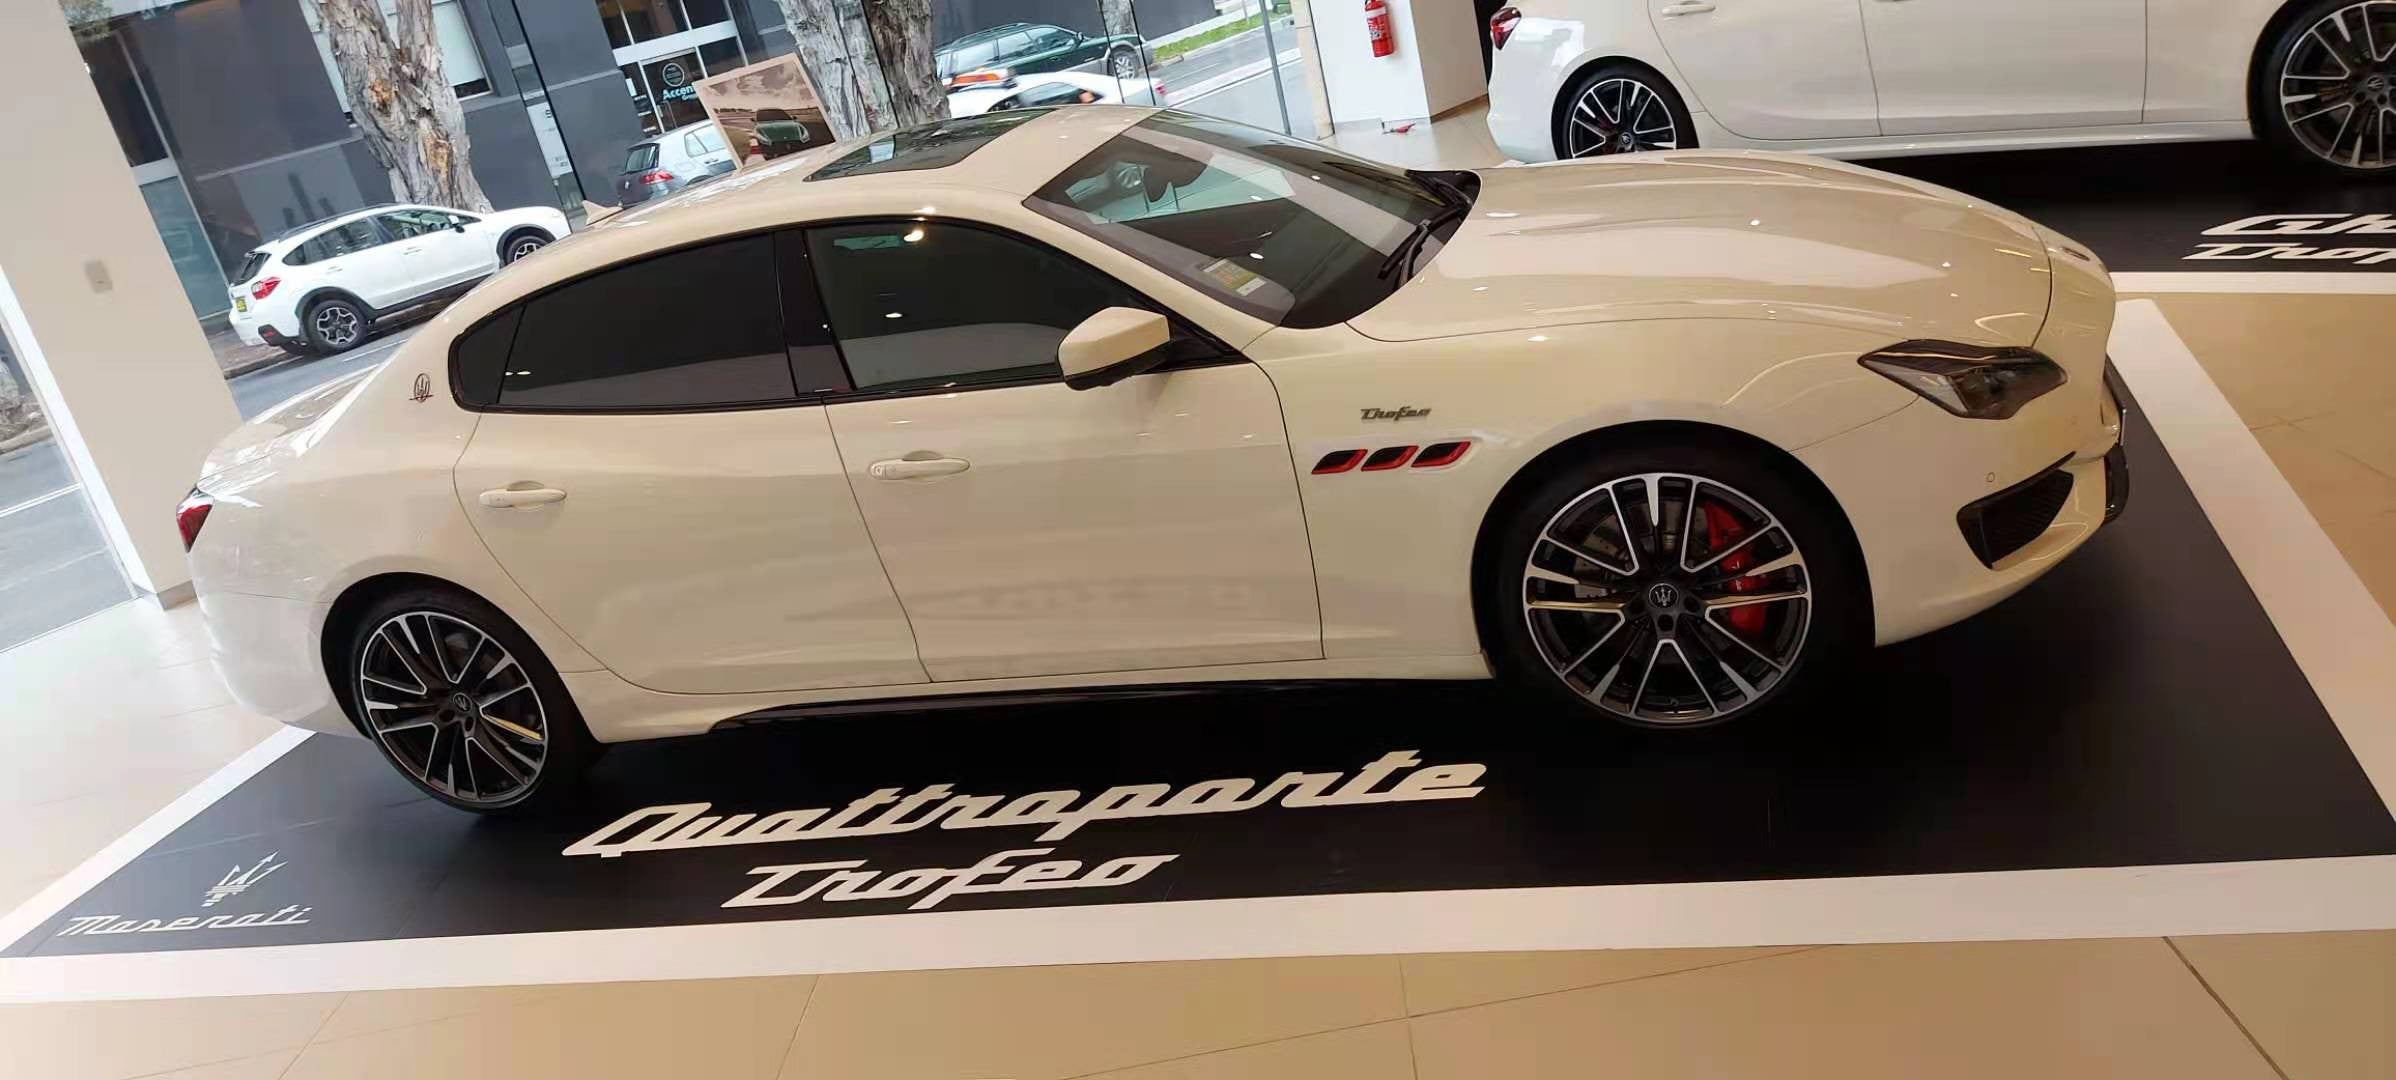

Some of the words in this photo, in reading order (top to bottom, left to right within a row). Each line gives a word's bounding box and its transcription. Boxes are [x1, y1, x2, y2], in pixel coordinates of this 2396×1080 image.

[663, 85, 695, 100] Accen
[2182, 243, 2396, 265] Tro
[562, 750, 1487, 858] Quattroporte
[720, 848, 1181, 910] Trofeo
[56, 905, 312, 937] Maserati
